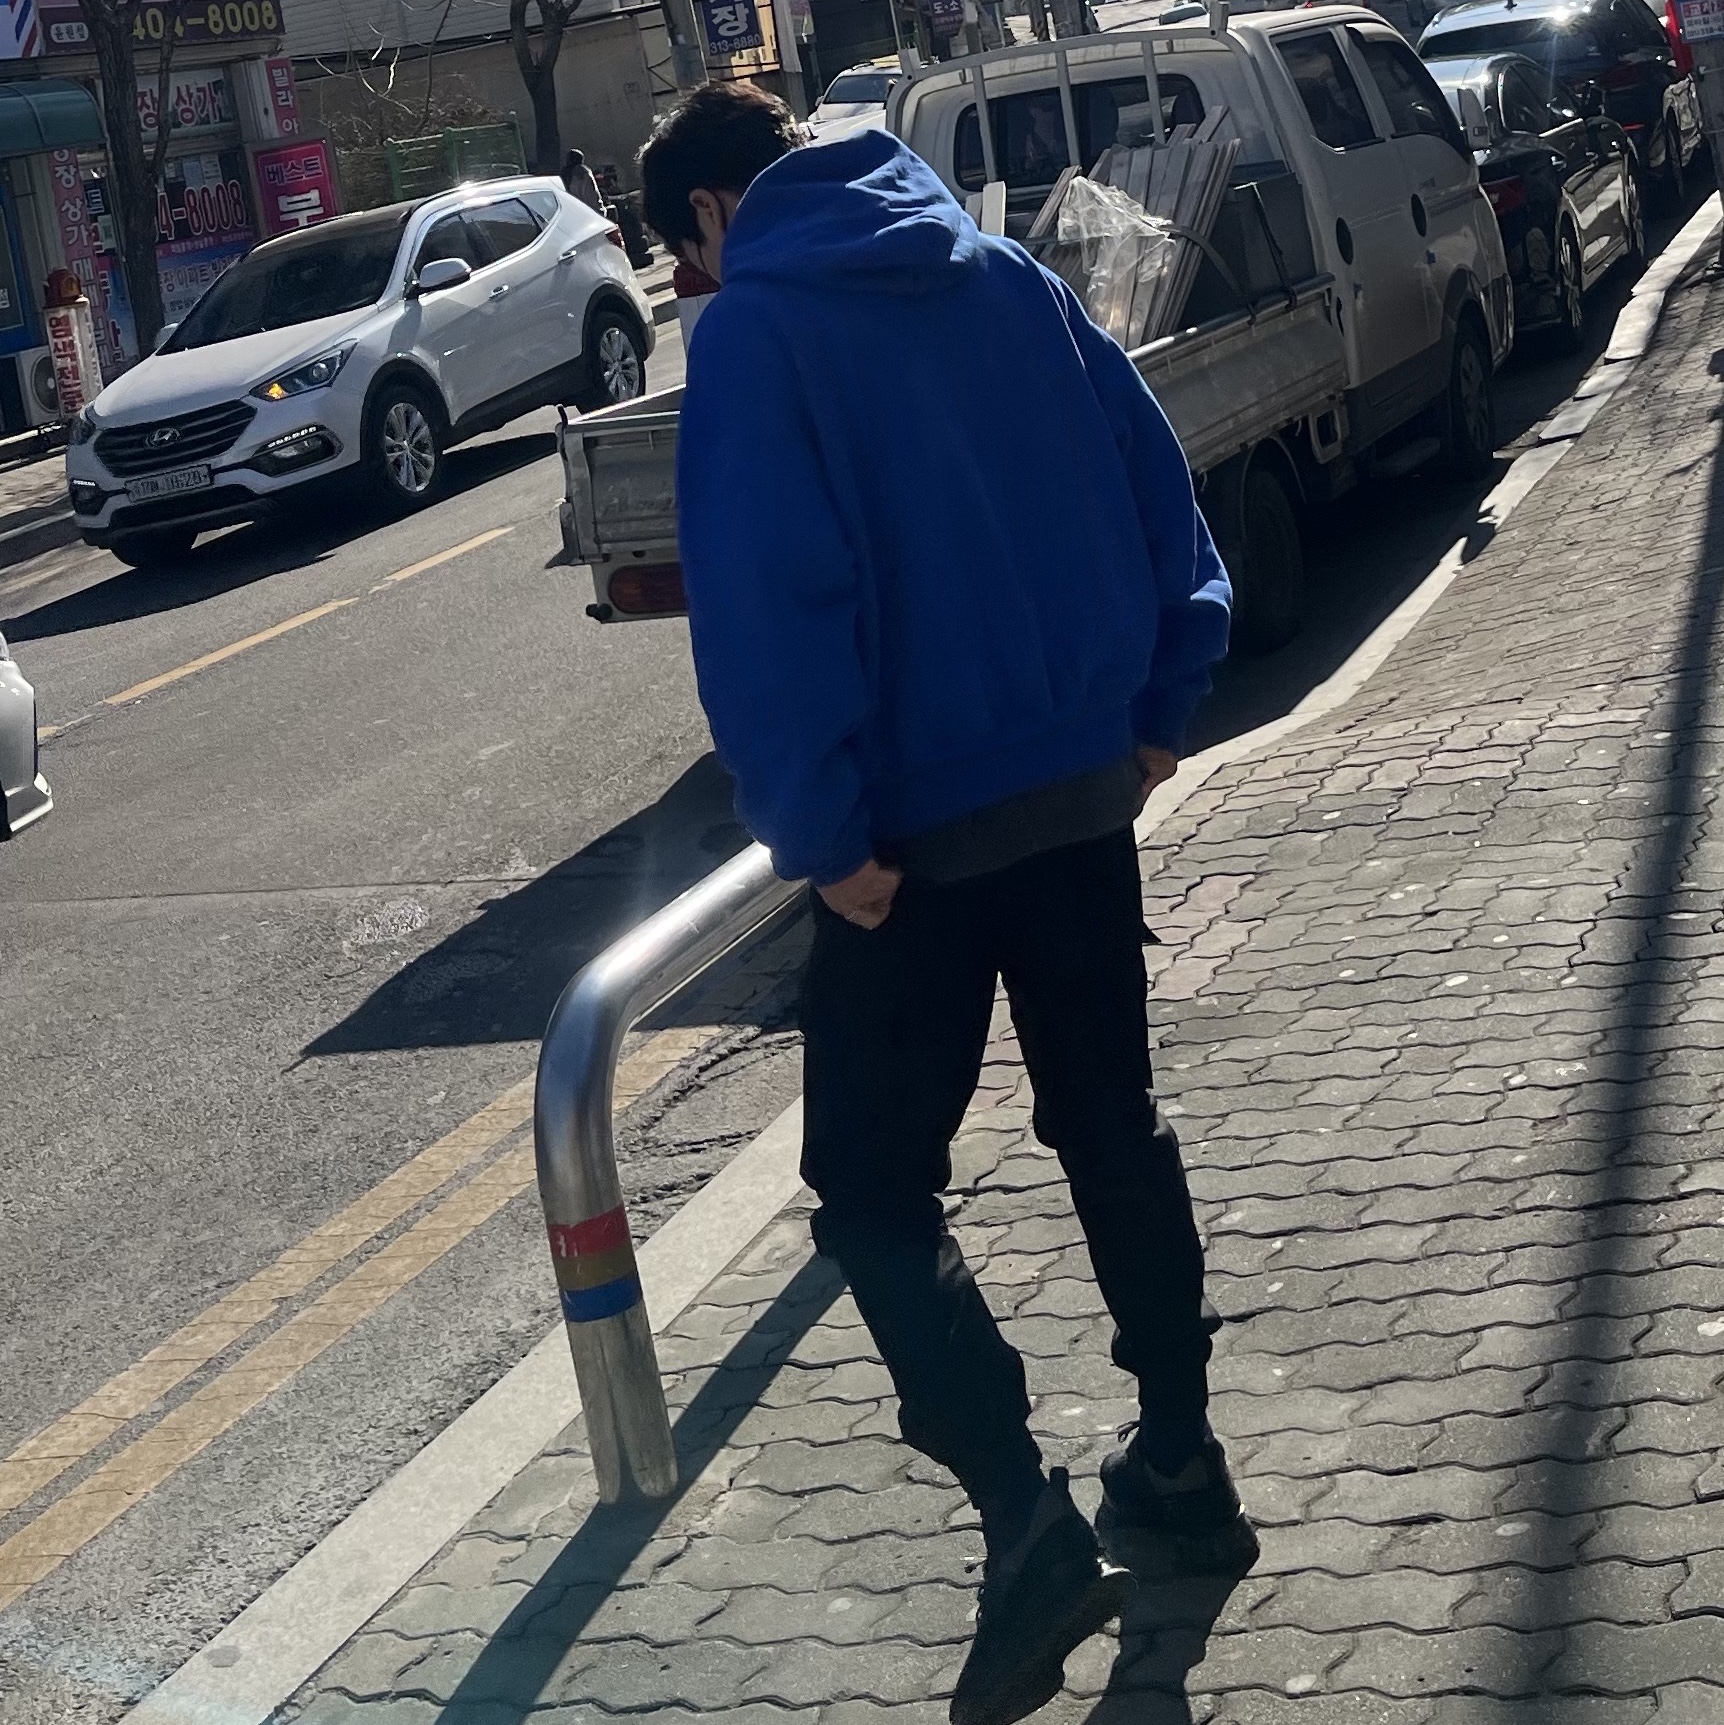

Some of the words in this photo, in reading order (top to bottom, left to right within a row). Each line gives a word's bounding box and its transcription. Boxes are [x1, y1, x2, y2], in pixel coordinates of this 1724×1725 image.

[710, 0, 749, 36] 장
[174, 80, 219, 126] 상가
[272, 67, 294, 107] 빌라
[264, 156, 323, 184] 베스트
[61, 197, 88, 246] 상가
[154, 179, 246, 240] 4-8008
